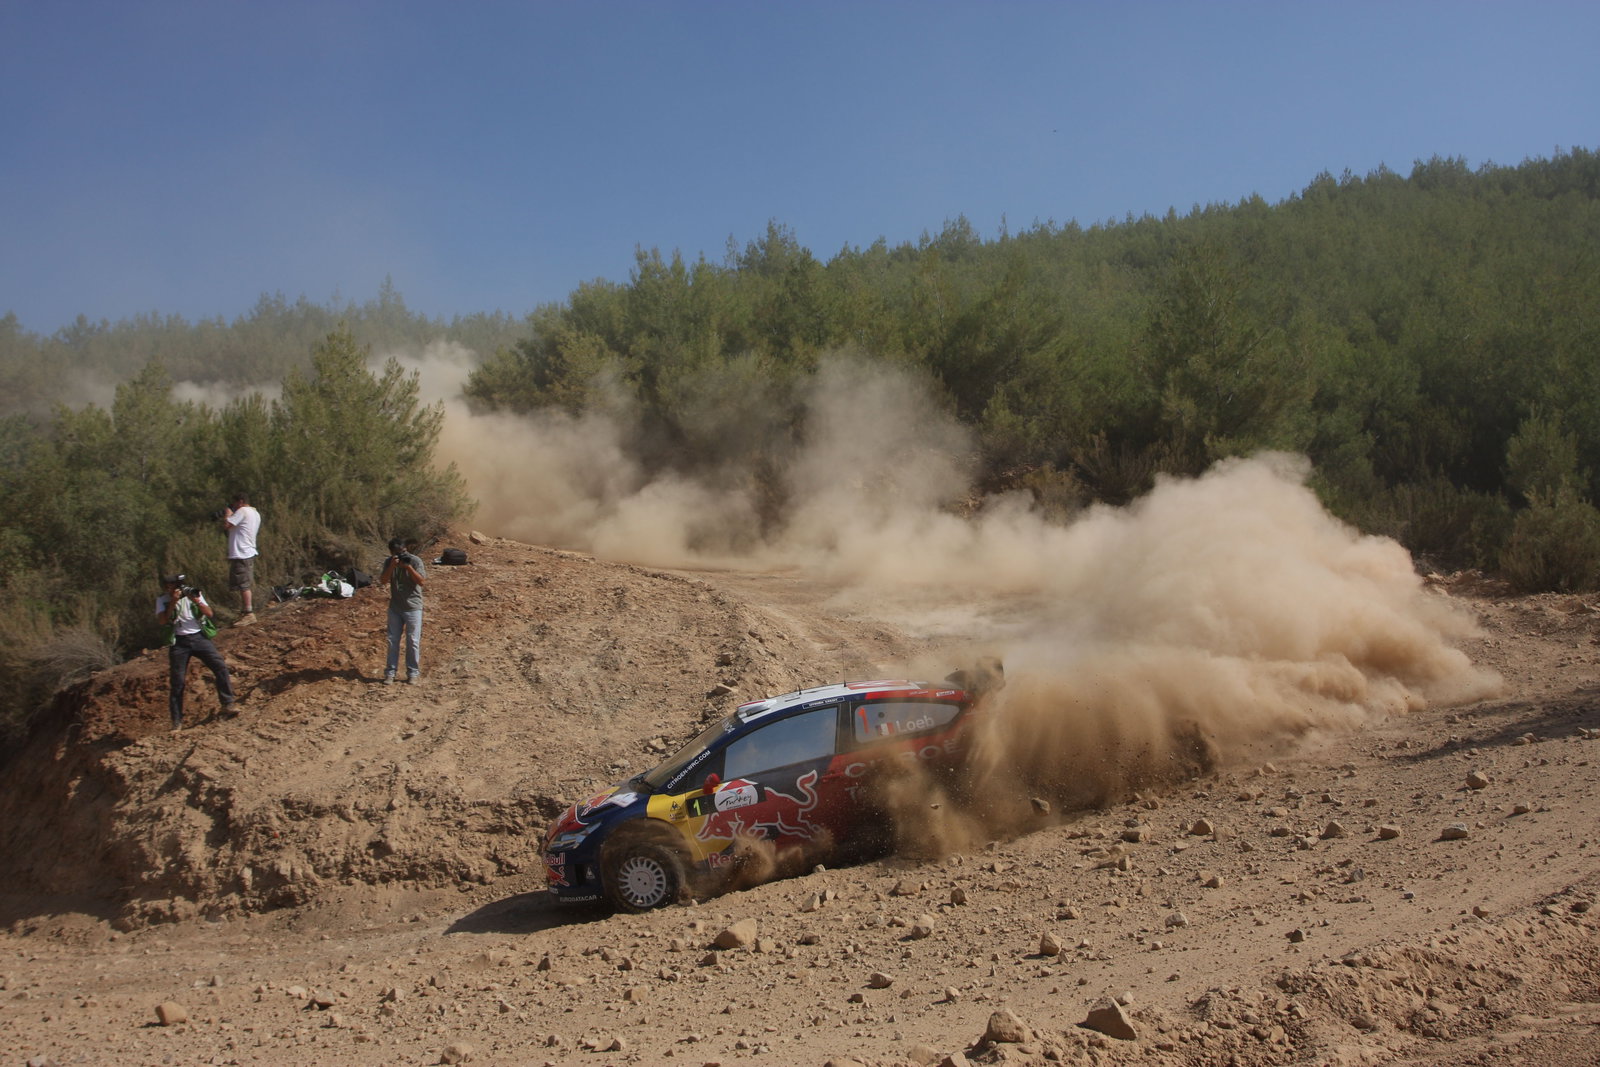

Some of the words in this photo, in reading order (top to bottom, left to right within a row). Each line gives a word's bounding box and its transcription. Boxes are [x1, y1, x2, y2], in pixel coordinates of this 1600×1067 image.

[858, 706, 869, 734] 1
[896, 715, 935, 733] Loeb
[693, 799, 701, 816] 1
